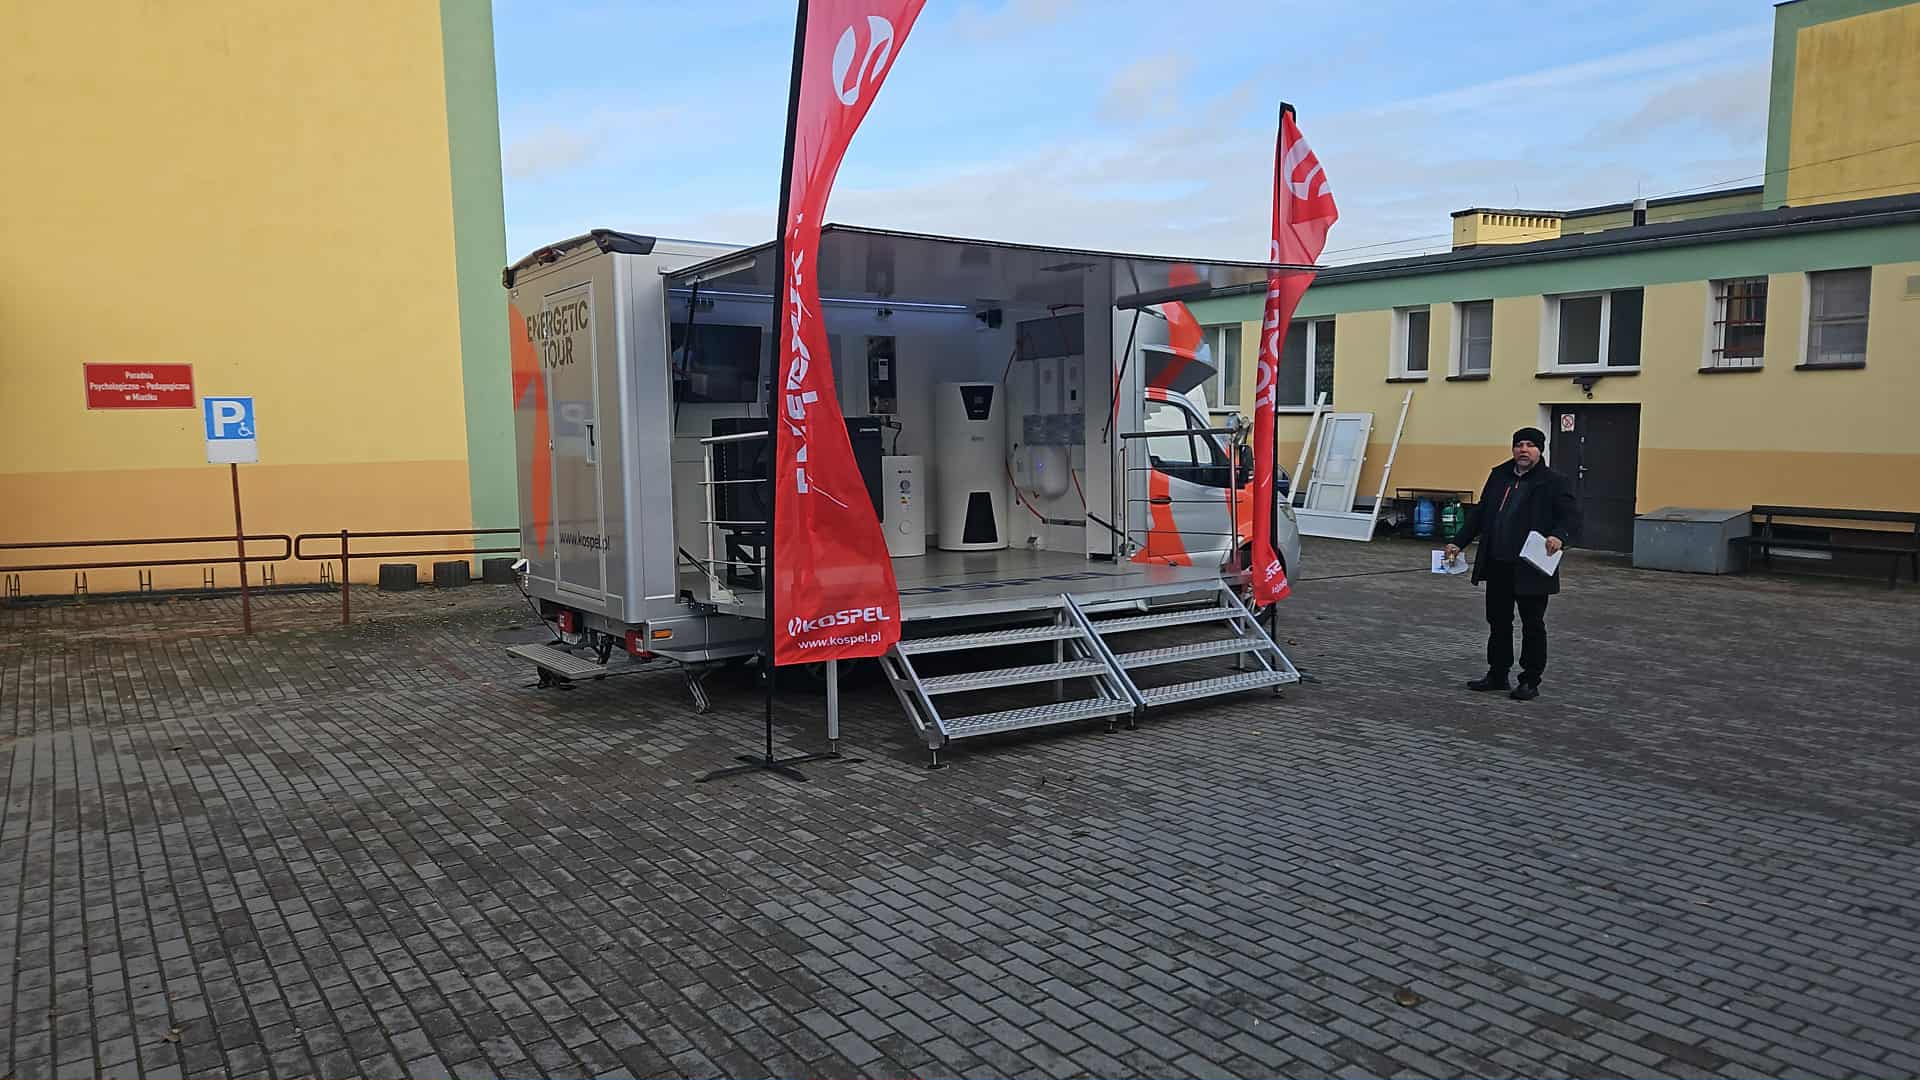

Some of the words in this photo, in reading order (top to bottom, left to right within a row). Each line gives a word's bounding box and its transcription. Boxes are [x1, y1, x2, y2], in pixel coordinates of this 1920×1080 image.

[526, 300, 588, 342] ENERGETIC
[543, 336, 574, 368] TOUR
[125, 371, 154, 379] Poradnia
[212, 401, 246, 437] P
[802, 606, 891, 633] KOSPEL
[798, 631, 881, 649] www.kospel.pl
